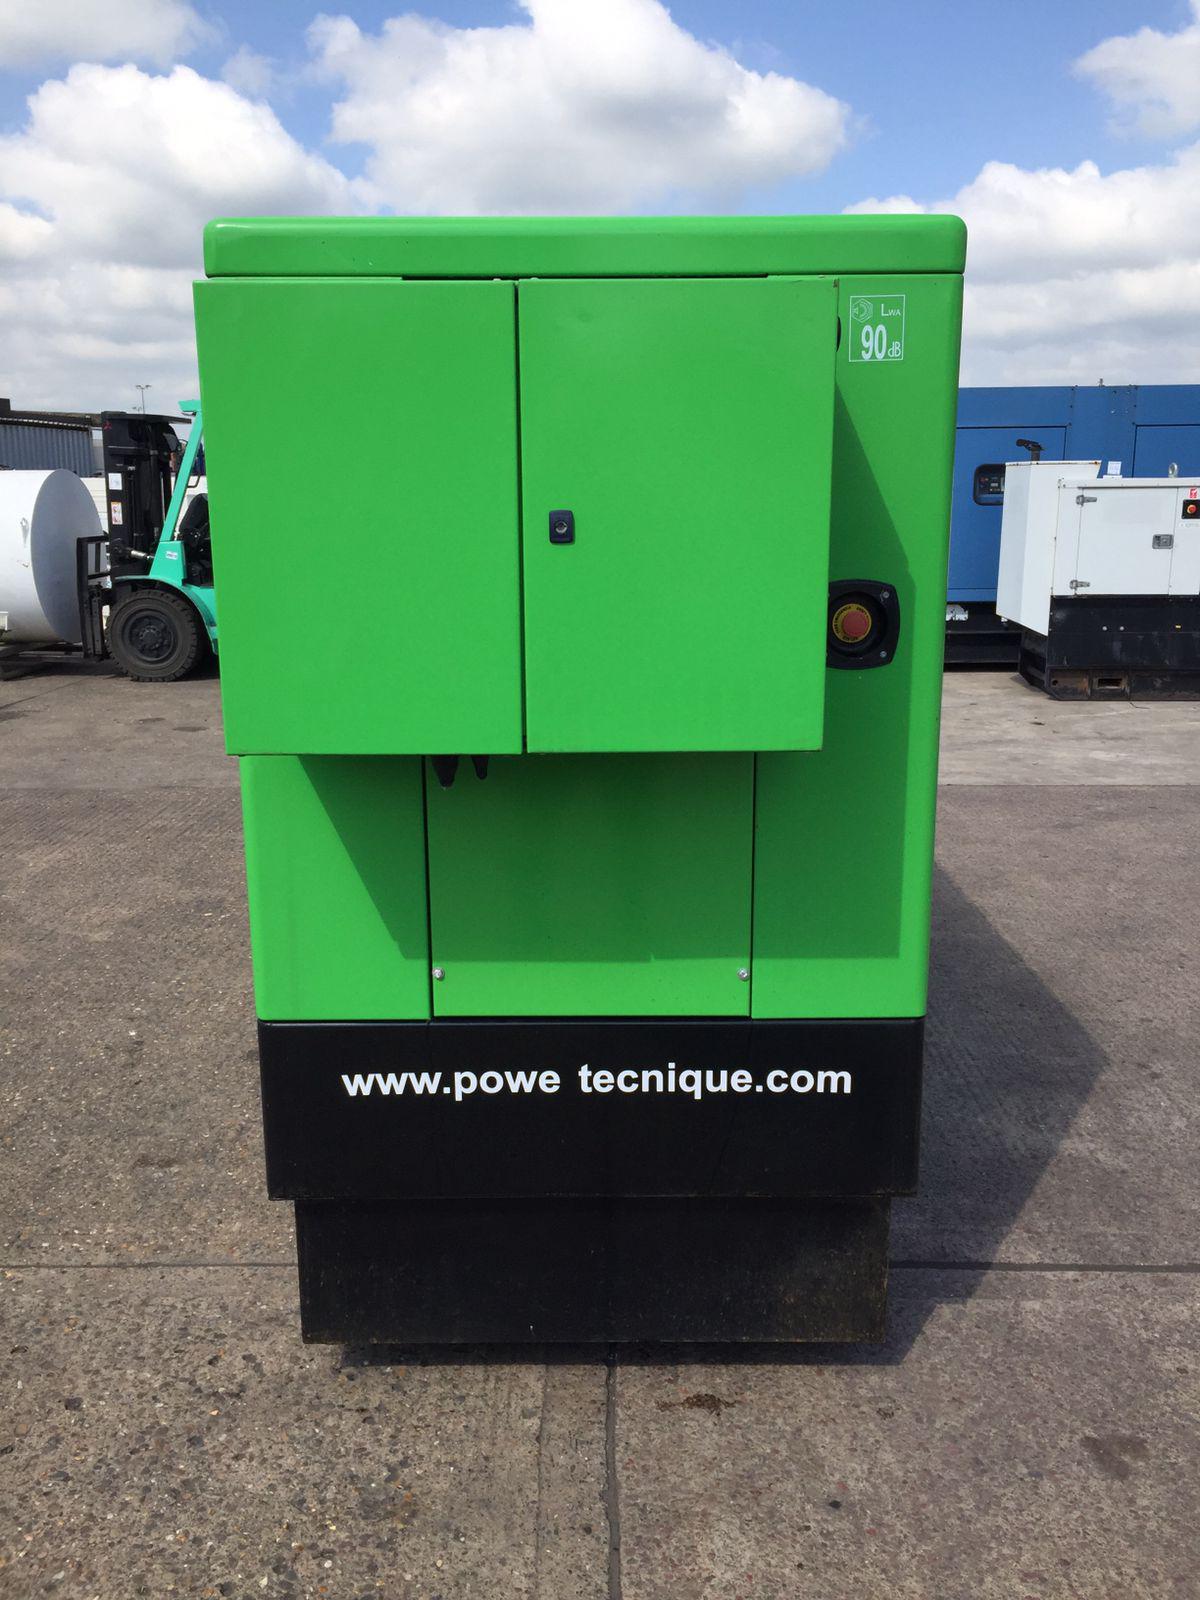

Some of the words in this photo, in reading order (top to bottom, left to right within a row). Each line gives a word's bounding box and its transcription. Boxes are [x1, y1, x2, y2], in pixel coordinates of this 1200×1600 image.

[861, 324, 887, 360] 90
[887, 341, 902, 358] dB
[341, 1070, 561, 1102] www.powe
[578, 1062, 852, 1100] tecnique.com
